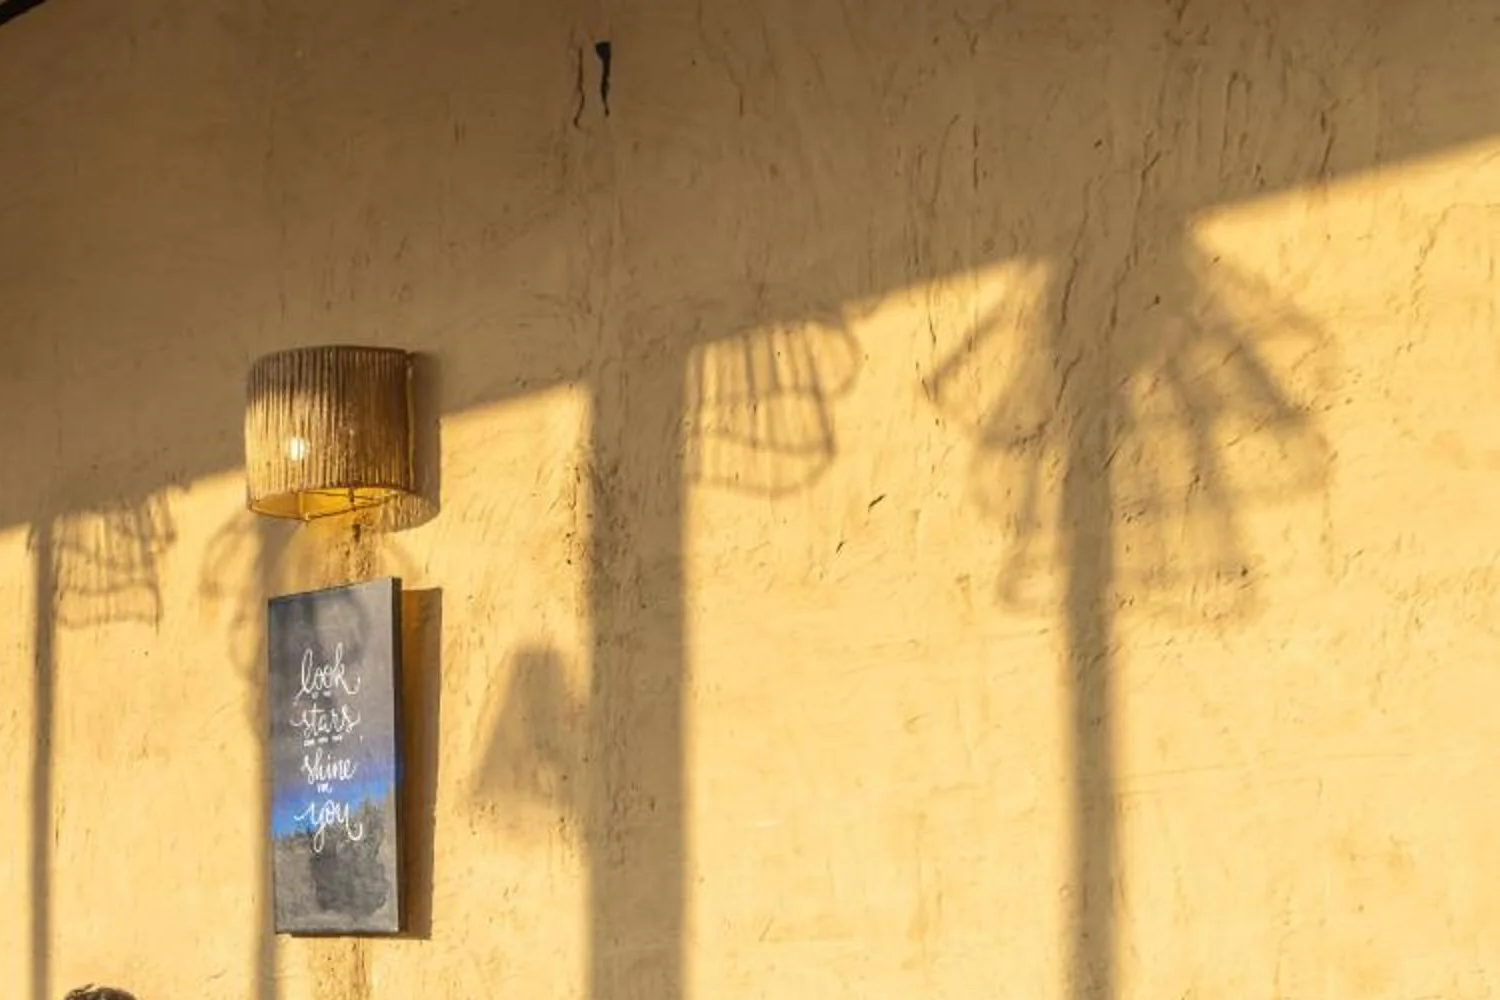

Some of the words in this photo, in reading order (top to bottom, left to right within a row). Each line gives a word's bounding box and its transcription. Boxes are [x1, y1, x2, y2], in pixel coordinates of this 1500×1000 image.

[293, 642, 361, 706] look
[301, 747, 359, 785] shine
[293, 799, 363, 853] you
